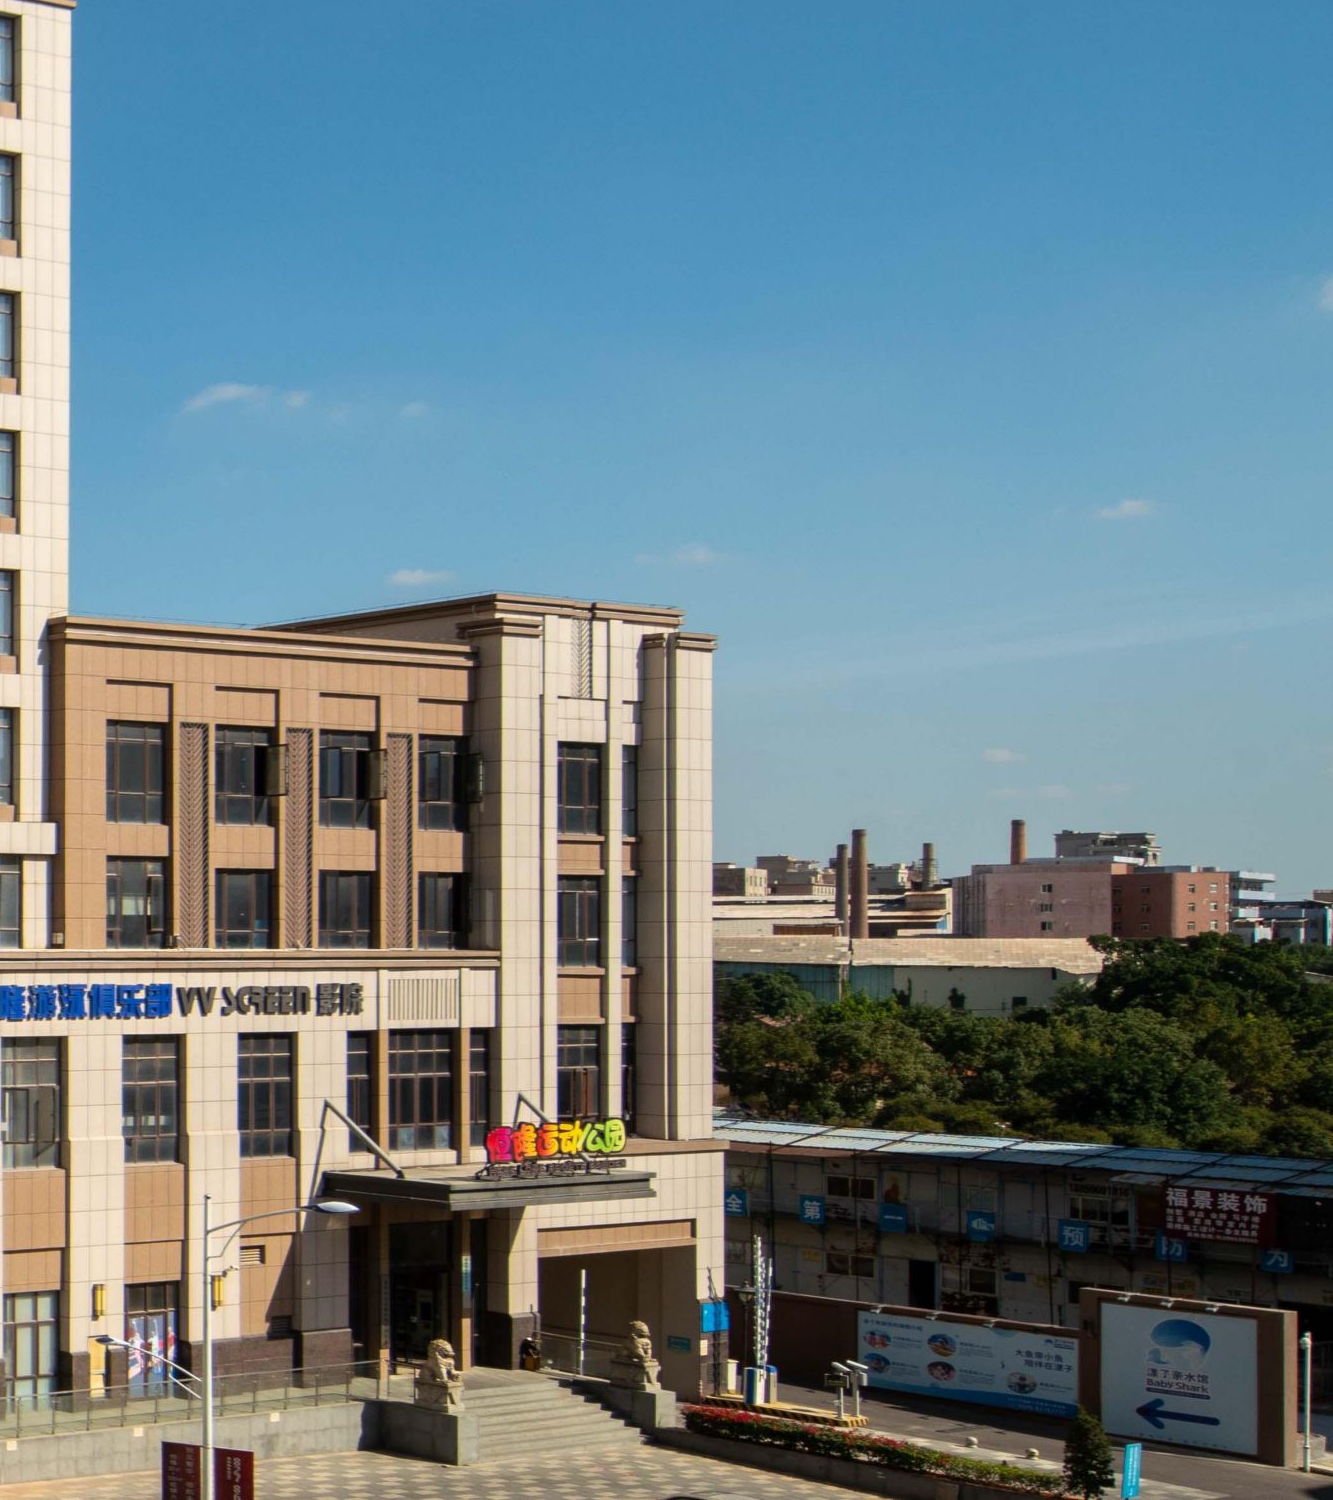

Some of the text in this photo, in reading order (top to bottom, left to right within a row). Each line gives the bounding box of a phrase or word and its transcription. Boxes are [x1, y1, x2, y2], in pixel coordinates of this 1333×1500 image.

[315, 982, 364, 1016] 影院
[1166, 1187, 1268, 1214] 福景装饰
[803, 1200, 822, 1220] 第
[1061, 1226, 1085, 1246] 预
[1146, 1378, 1174, 1389] Baby
[1175, 1382, 1209, 1393] Shark
